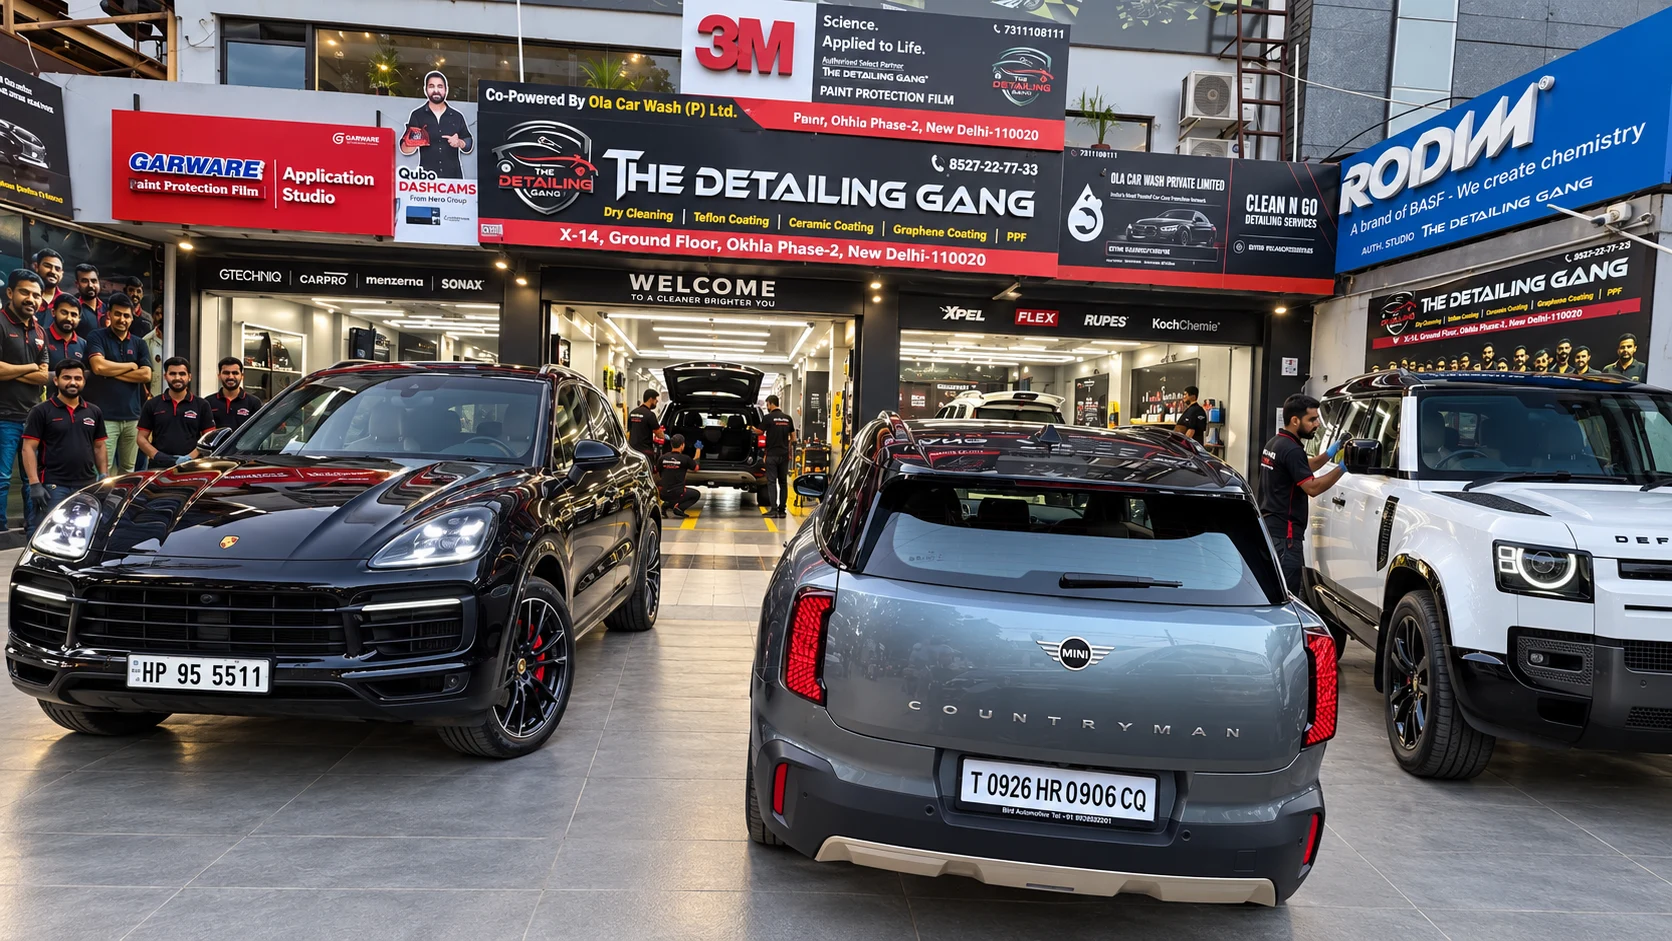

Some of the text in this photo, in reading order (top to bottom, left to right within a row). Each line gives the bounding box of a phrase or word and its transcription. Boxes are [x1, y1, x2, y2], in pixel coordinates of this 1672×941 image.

[823, 15, 878, 32] Science.
[1004, 25, 1064, 39] 7311108111
[695, 13, 795, 76] 3M
[822, 35, 926, 55] Applied to Life.
[822, 67, 840, 77] THE
[843, 70, 894, 81] DETAILING
[485, 87, 738, 118] Co-Powered By Ola Car Wash (P) Ltd.
[820, 85, 955, 106] PAINT PROTECTION FILM
[870, 117, 923, 134] Phase-2,
[926, 122, 954, 135] New
[957, 124, 1039, 141] Delhi-110020
[1339, 82, 1539, 215] RODIM
[129, 152, 265, 180] GARWARE
[398, 167, 436, 181] Qubo
[534, 167, 555, 176] THE
[948, 157, 1038, 176] 8527-22-77-33
[282, 167, 375, 186] Application
[498, 175, 592, 190] DETAILING
[601, 148, 1036, 218] THE DETAILING GANG
[1110, 172, 1225, 192] OLA CAR WASH PRIVATE LIMITED
[1349, 223, 1358, 236] A
[1360, 210, 1392, 234] brand
[1394, 205, 1409, 220] of
[1410, 191, 1446, 217] BASF
[1456, 183, 1480, 200] We
[1483, 160, 1536, 190] create
[1540, 121, 1648, 170] chemistry
[164, 181, 228, 195] Protection
[231, 185, 259, 196] Film
[282, 187, 336, 205] Studio
[399, 181, 477, 195] DASHCAMS
[410, 194, 467, 204] From Hero Group
[1246, 194, 1318, 216] CLEAN N GO
[603, 206, 674, 223] Dry Cleaning
[693, 211, 769, 229] Teflon Coating
[1245, 214, 1317, 229] DETAILING SERVICES
[1361, 174, 1594, 256] AUTH. STUDIO THE DETAILING GANG
[788, 217, 874, 235] Ceramic Coating
[893, 224, 987, 242] Graphene Coating
[1006, 231, 1027, 243] PPF
[559, 227, 986, 266] X-14, Ground Floor, Okhla Phase-2, New Delhi-110020
[219, 268, 282, 283] GTECHNIQ
[300, 272, 349, 286] CARPRO
[366, 275, 424, 287] menzerna
[441, 278, 483, 291] SONAX
[629, 273, 776, 298] WELCOME
[1420, 256, 1630, 314] THE DETAILING GANG
[1606, 286, 1623, 296] PPF
[631, 293, 775, 308] TO A CLEANER BRIGHTER YOU
[940, 305, 985, 322] XPEL
[1017, 311, 1056, 324] FLEX
[1083, 314, 1128, 328] RUPES
[1062, 648, 1089, 660] MINI
[142, 661, 167, 683] HP
[177, 663, 201, 685] 95
[212, 664, 260, 687] 5511
[907, 700, 1241, 738] COUNTRYMAN
[970, 771, 1147, 813] T 0926 HR 0906 CQ
